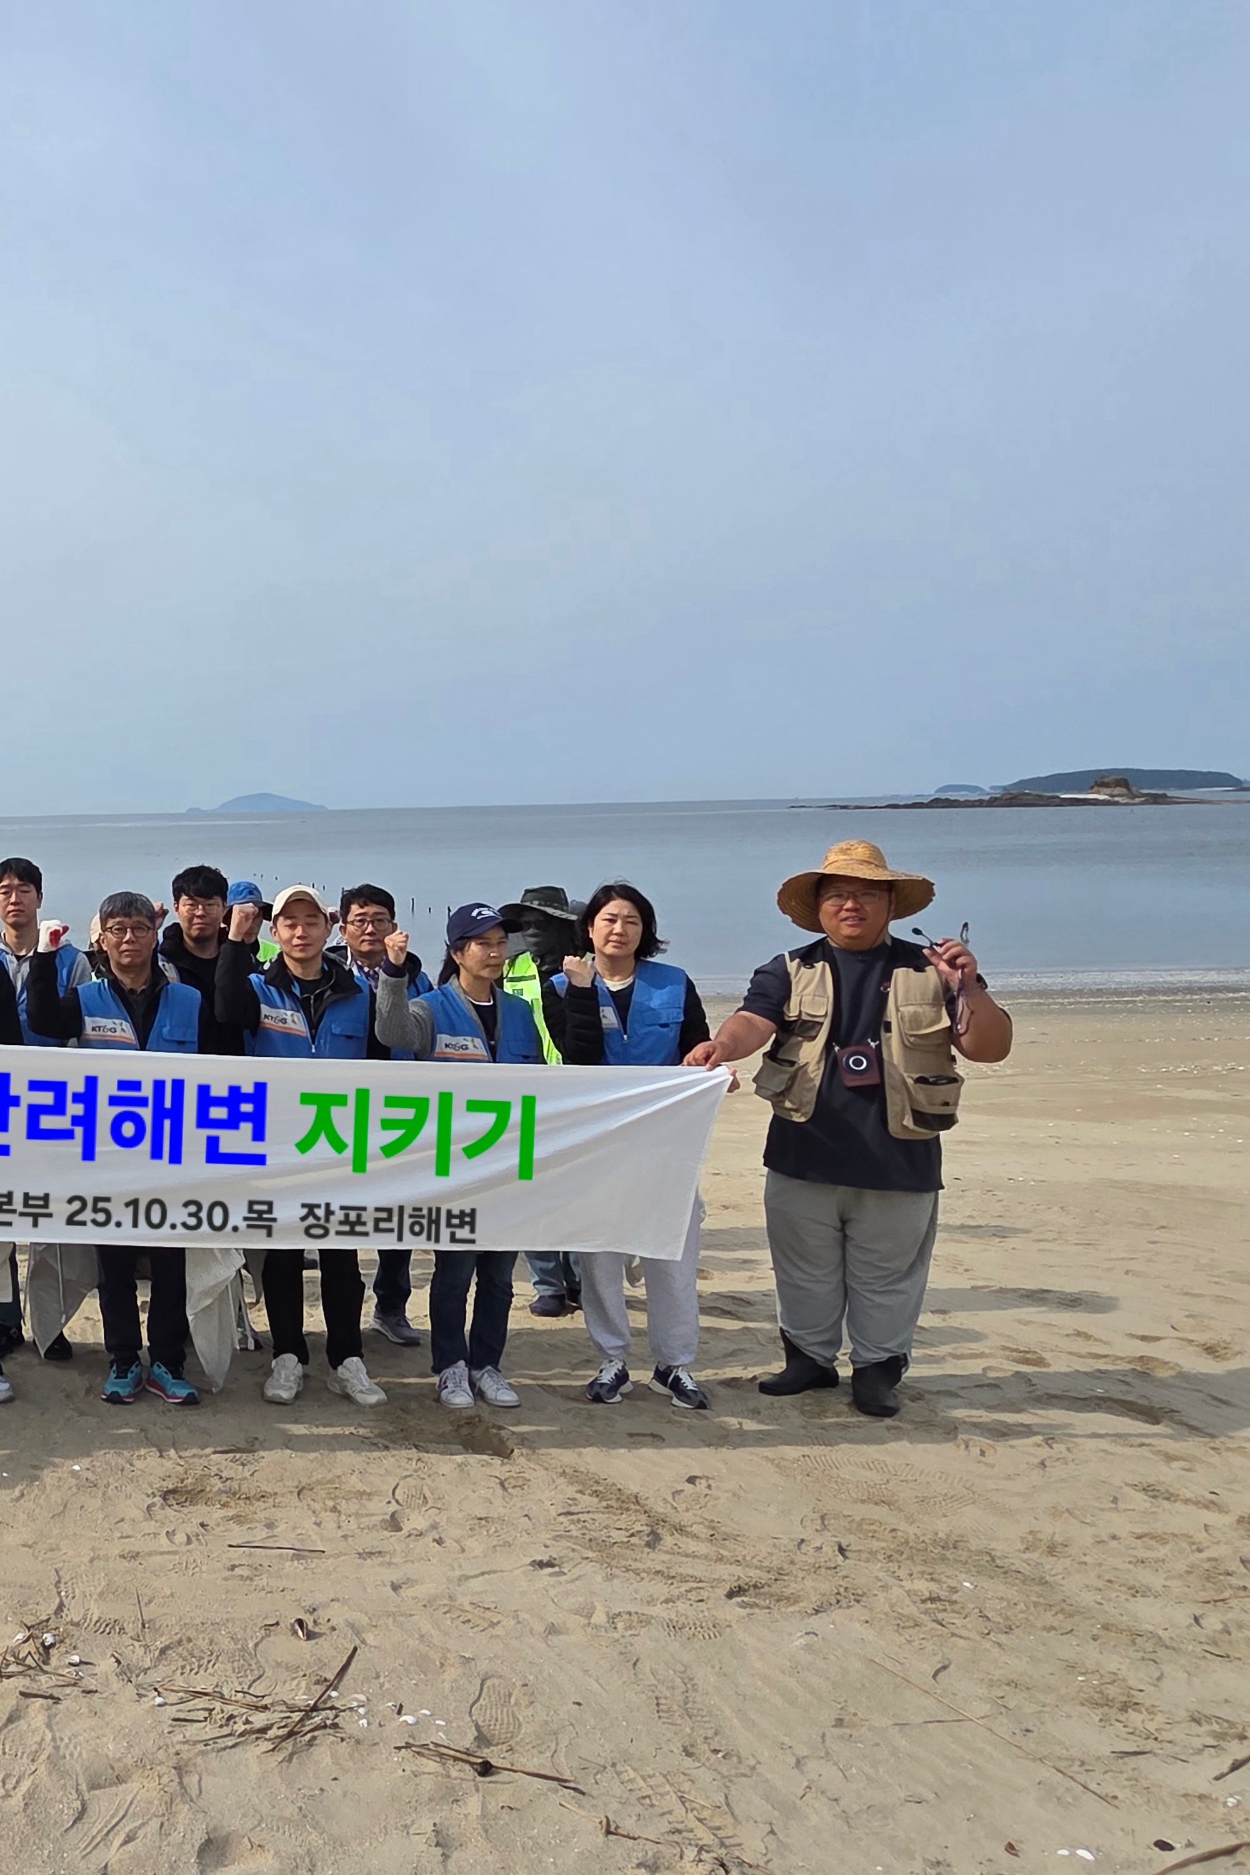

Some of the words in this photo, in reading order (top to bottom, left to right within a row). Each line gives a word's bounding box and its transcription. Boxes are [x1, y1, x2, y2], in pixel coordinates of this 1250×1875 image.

[91, 1025, 117, 1034] KT&G
[263, 1013, 288, 1025] KT&G
[296, 1089, 536, 1180] 지키기
[65, 1195, 277, 1238] 25.10.30.목
[299, 1202, 477, 1244] 장포리해변
